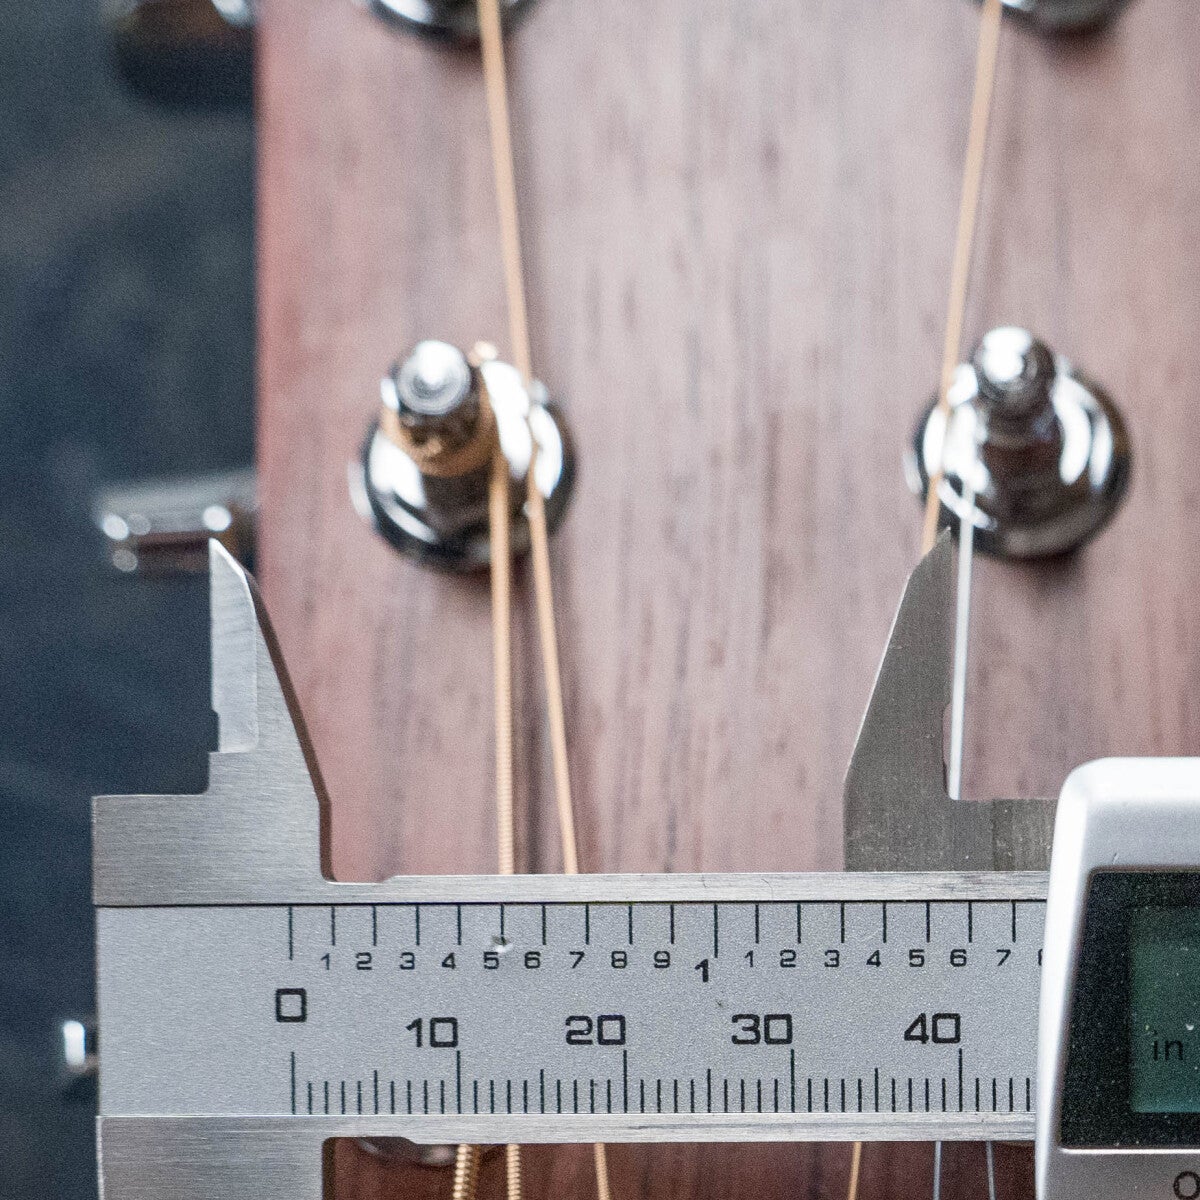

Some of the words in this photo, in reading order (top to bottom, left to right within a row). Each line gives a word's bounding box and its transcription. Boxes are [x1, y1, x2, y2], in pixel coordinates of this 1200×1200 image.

[321, 953, 330, 971] 1
[355, 951, 372, 971] 2
[399, 951, 415, 970] 3
[441, 952, 456, 970] 4
[483, 951, 500, 970] 5
[524, 951, 541, 969] 6
[569, 951, 585, 969] 7
[610, 950, 628, 969] 8
[653, 950, 671, 969] 9
[694, 958, 709, 983] 1
[744, 950, 754, 968] 1
[779, 949, 797, 968] 2
[824, 949, 840, 968] 3
[866, 950, 882, 968] 4
[908, 948, 925, 968] 5
[949, 948, 967, 968] 6
[996, 949, 1011, 966] 7
[275, 987, 308, 1023] 0
[406, 1016, 459, 1048] 10
[565, 1014, 626, 1046] 20
[731, 1013, 793, 1045] 30
[903, 1012, 961, 1045] 40
[1150, 1030, 1185, 1063] in
